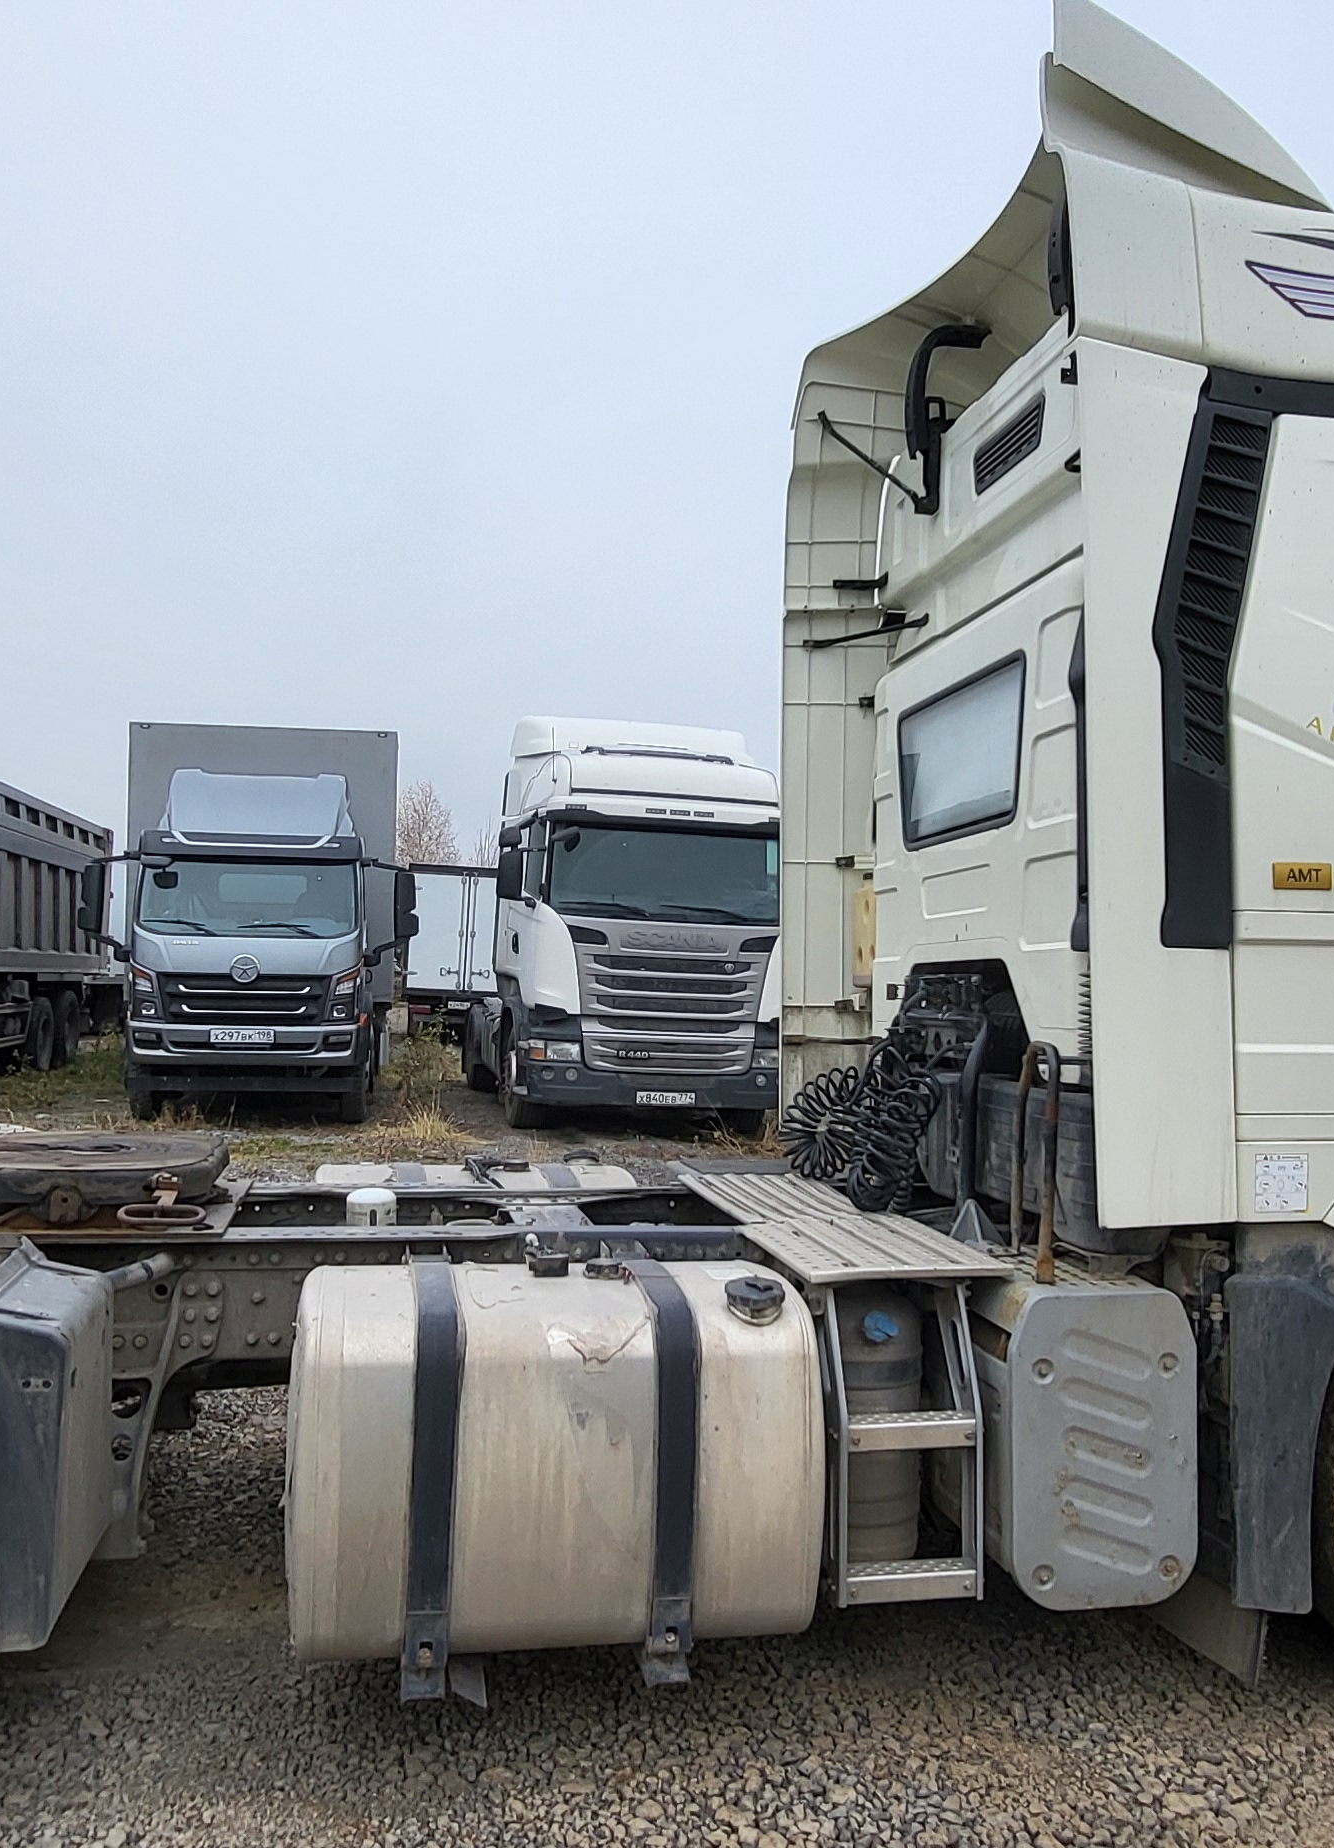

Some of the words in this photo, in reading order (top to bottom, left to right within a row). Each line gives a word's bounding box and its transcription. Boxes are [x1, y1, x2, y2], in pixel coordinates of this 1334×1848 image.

[1306, 716, 1323, 736] A
[1285, 867, 1323, 884] AMT
[626, 930, 723, 950] SCANIA
